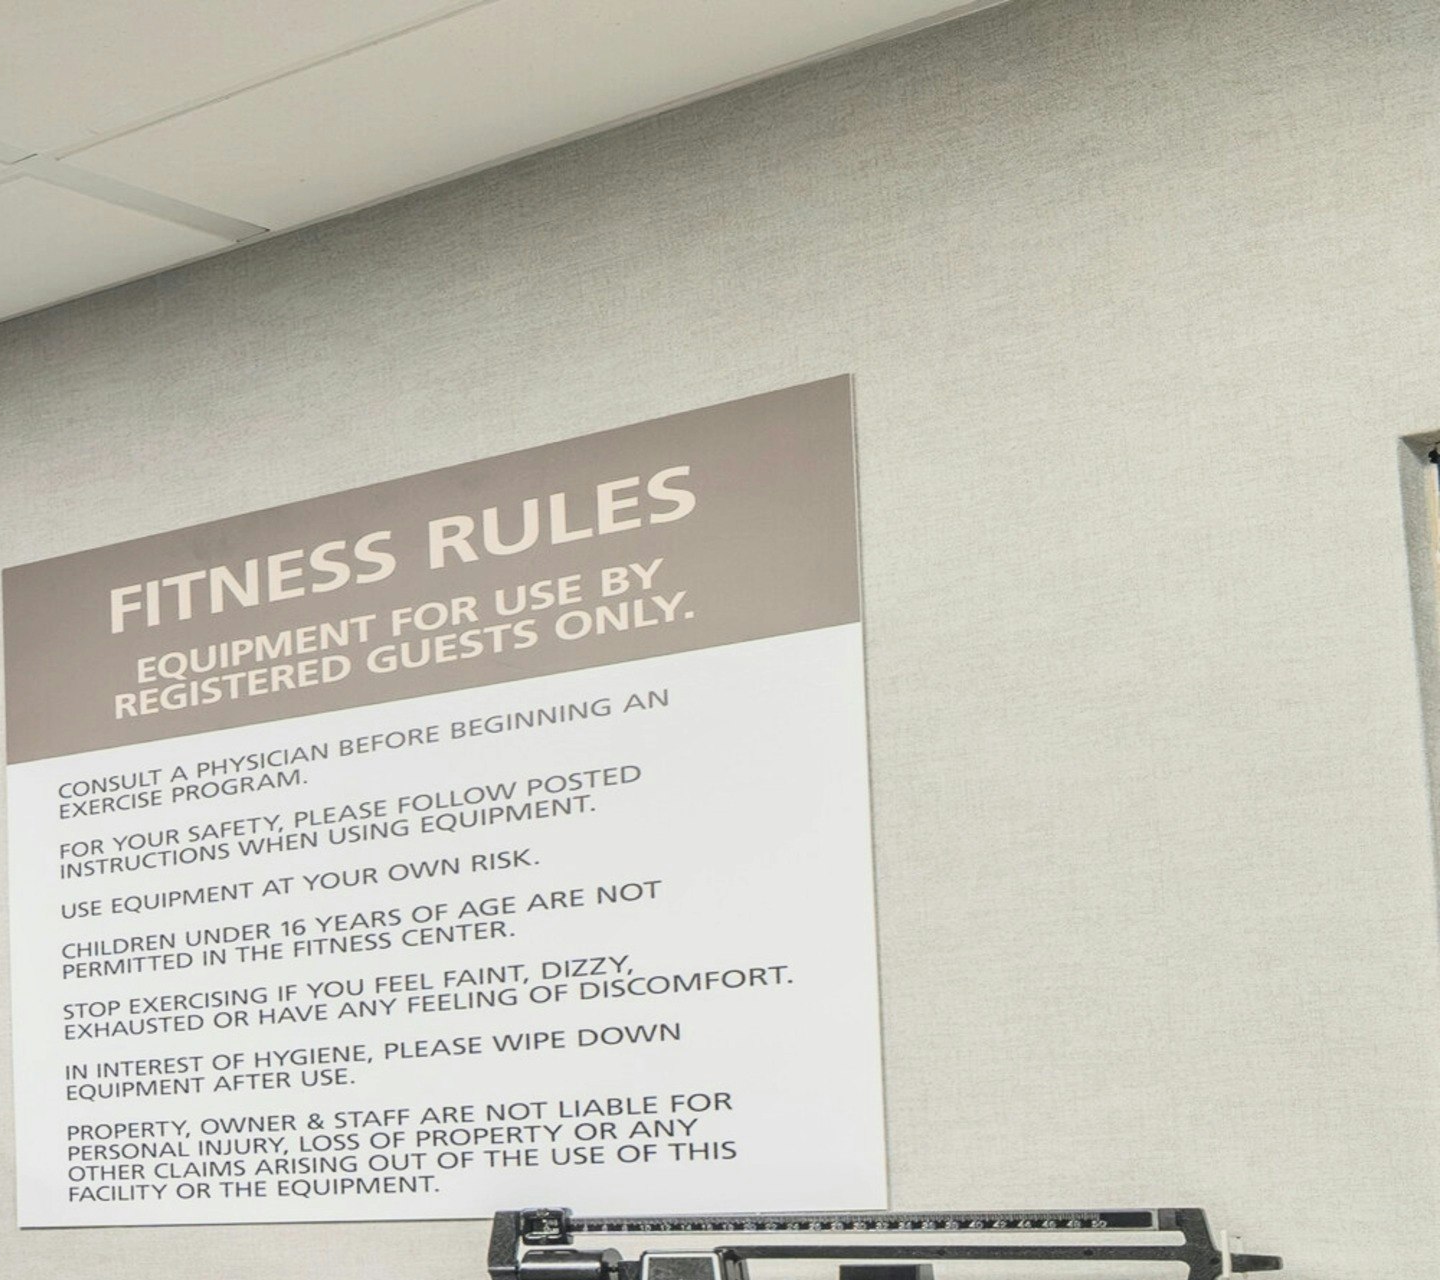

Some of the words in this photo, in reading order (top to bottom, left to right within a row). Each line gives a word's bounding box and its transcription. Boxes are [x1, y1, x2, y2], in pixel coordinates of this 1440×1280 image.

[110, 530, 396, 634] FITNESS
[428, 465, 695, 569] RULES
[137, 614, 376, 683] EQUIPMENT
[391, 596, 478, 636] FOR
[495, 574, 582, 615] USE
[601, 557, 663, 597] BY
[115, 655, 351, 719] REGISTERED
[366, 619, 538, 673] GUESTS
[555, 590, 694, 640] ONLY.
[58, 768, 162, 799] CONSULT
[170, 765, 188, 782] A
[197, 742, 328, 778] PHYSICIAN
[339, 725, 438, 756] BEFORE
[451, 698, 611, 739] BEGINNING
[623, 689, 668, 712] AN
[59, 789, 162, 819] EXERCISE
[172, 768, 307, 803] PROGRAM.
[60, 839, 104, 859] FOR
[112, 828, 179, 851] YOUR
[188, 814, 283, 842] SAFETY,
[294, 799, 386, 828] PLEASE
[398, 781, 516, 813] FOLLOW
[527, 765, 641, 796] POSTED
[60, 842, 230, 879] INSTRUCTIONS
[238, 831, 317, 856] WHEN
[329, 818, 408, 844] USING
[421, 794, 595, 833] EQUIPMENT.
[61, 900, 101, 919] USE
[111, 881, 253, 913] EQUIPMENT
[261, 876, 294, 896] AT
[302, 867, 378, 890] YOUR
[388, 857, 459, 881] OWN
[471, 848, 539, 872] RISK.
[61, 933, 175, 959] CHILDREN
[185, 922, 270, 946] UNDER
[281, 918, 306, 936] 16
[315, 908, 401, 932] YEARS
[411, 903, 447, 923] OF
[458, 896, 515, 919] AGE
[526, 888, 584, 912] ARE
[597, 880, 661, 904] NOT
[63, 952, 193, 979] PERMITTED
[203, 948, 226, 966] IN
[235, 942, 282, 962] THE
[293, 932, 391, 957] FITNESS
[401, 920, 514, 946] CENTER.
[63, 1000, 120, 1020] STOP
[129, 987, 267, 1014] EXERCISING
[278, 984, 297, 1001] IF
[306, 978, 363, 999] YOU
[375, 973, 433, 994] FEEL
[444, 964, 528, 987] FAINT,
[542, 954, 632, 979] DIZZY,
[65, 1014, 203, 1040] EXHAUSTED
[213, 1010, 248, 1028] OR
[259, 1003, 327, 1025] HAVE
[338, 998, 396, 1018] ANY
[408, 988, 517, 1013] FEELING
[529, 984, 567, 1003] OF
[580, 965, 793, 999] DISCOMFORT.
[65, 1064, 87, 1080] IN
[97, 1056, 203, 1078] INTEREST
[212, 1053, 244, 1070] OF
[254, 1044, 372, 1068] HYGIENE,
[384, 1036, 481, 1059] PLEASE
[492, 1030, 565, 1052] WIPE
[578, 1022, 680, 1047] DOWN
[66, 1076, 205, 1102] EQUIPMENT
[213, 1071, 290, 1092] AFTER
[301, 1067, 355, 1087] USE.
[67, 1120, 190, 1141] PROPERTY,
[200, 1115, 296, 1135] OWNER
[307, 1113, 324, 1130] &
[334, 1108, 409, 1129] STAFF
[420, 1105, 474, 1124] ARE
[486, 1101, 547, 1121] NOT
[559, 1095, 657, 1118] LIABLE
[671, 1092, 732, 1113] FOR
[68, 1141, 189, 1161] PERSONAL
[198, 1136, 288, 1155] INJURY,
[300, 1133, 359, 1152] LOSS
[369, 1131, 404, 1149] OF
[416, 1124, 562, 1147] PROPERTY
[574, 1122, 617, 1141] OR
[628, 1118, 697, 1138] ANY
[68, 1164, 145, 1182] OTHER
[154, 1159, 245, 1178] CLAIMS
[254, 1155, 357, 1175] ARISING
[368, 1152, 426, 1171] OUT
[437, 1151, 473, 1169] OF
[483, 1148, 538, 1167] THE
[551, 1145, 604, 1165] USE
[617, 1144, 657, 1163] OF
[667, 1140, 737, 1161] THIS
[69, 1184, 167, 1202] FACILITY
[176, 1182, 211, 1199] OR
[219, 1180, 266, 1197] THE
[277, 1175, 439, 1198] EQUIPMENT.
